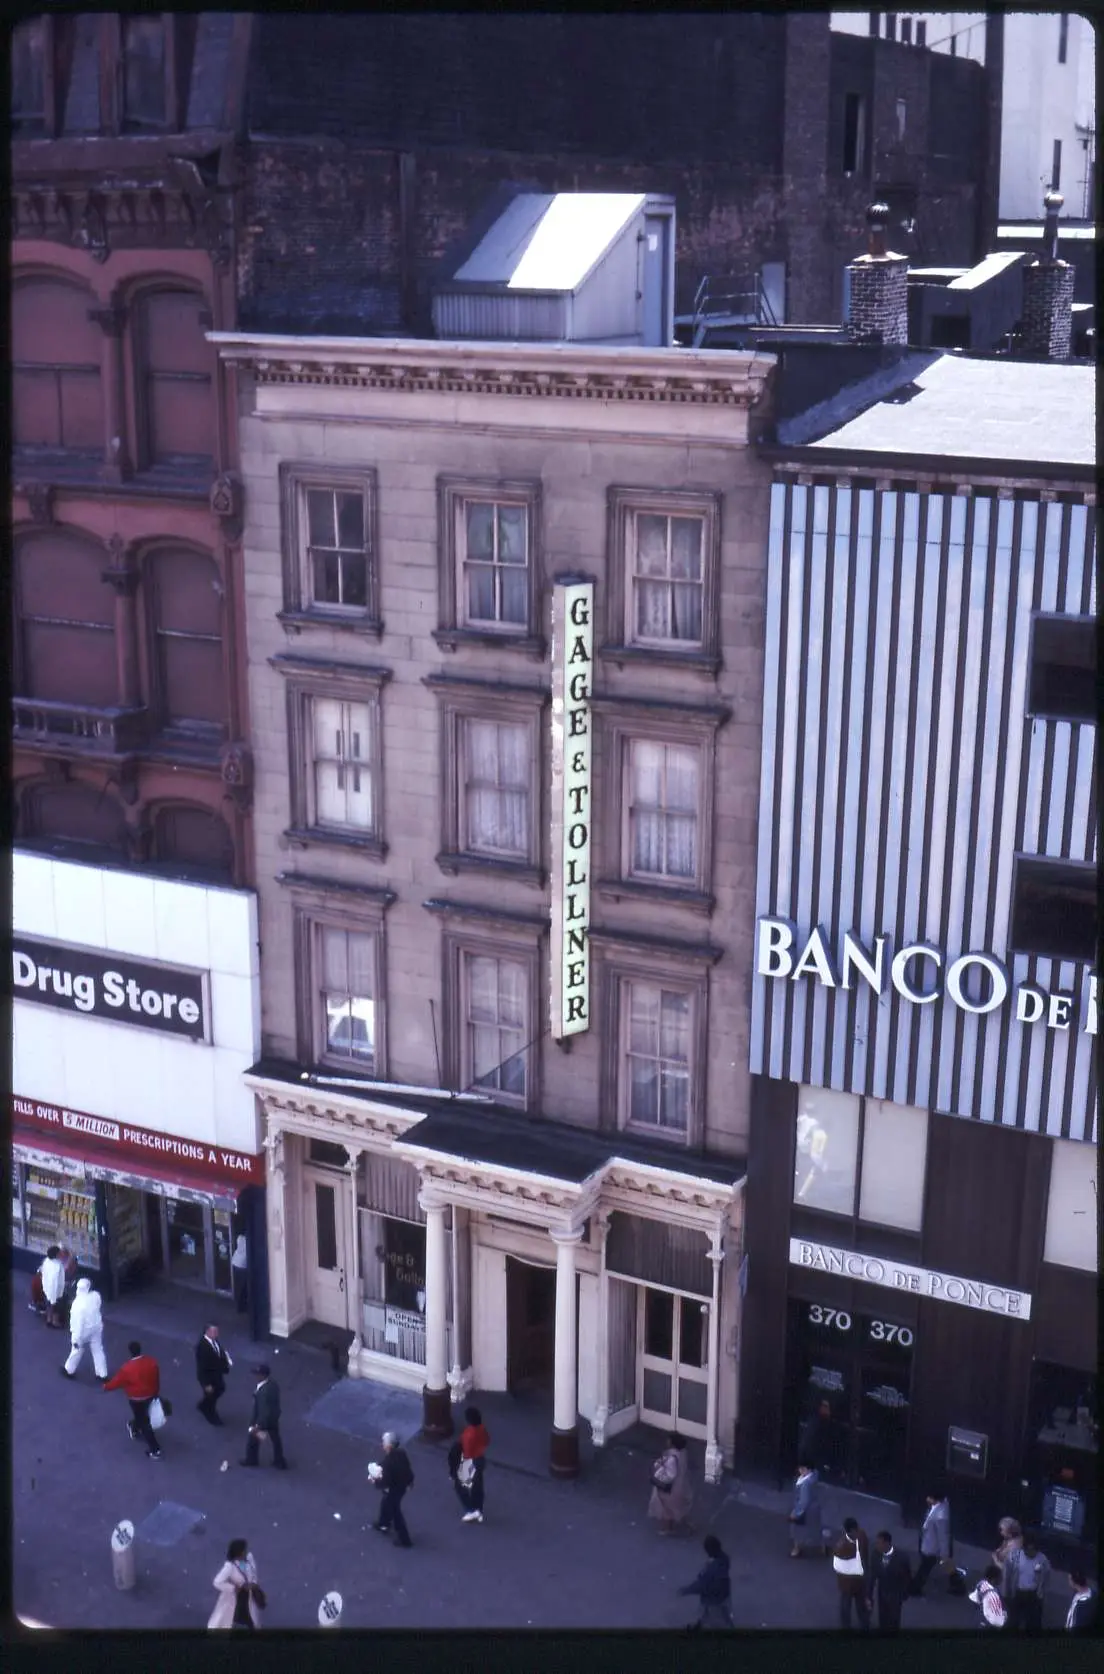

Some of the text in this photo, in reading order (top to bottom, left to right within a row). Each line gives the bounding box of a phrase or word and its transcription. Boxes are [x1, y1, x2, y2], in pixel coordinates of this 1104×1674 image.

[568, 598, 591, 737] GAGE
[566, 785, 589, 1023] TOLLNER
[13, 951, 200, 1024] Drug Store
[757, 915, 1008, 1014] BANCO
[1016, 987, 1073, 1030] DE
[36, 1106, 60, 1122] OVER
[75, 1114, 116, 1137] MILLION
[123, 1128, 204, 1160] PRESCRIPTIONS
[208, 1147, 217, 1164] A
[222, 1153, 252, 1172] YEAR
[799, 1242, 1022, 1315] BANCO DE PONCE
[809, 1304, 852, 1331] 370
[870, 1320, 914, 1347] 370
